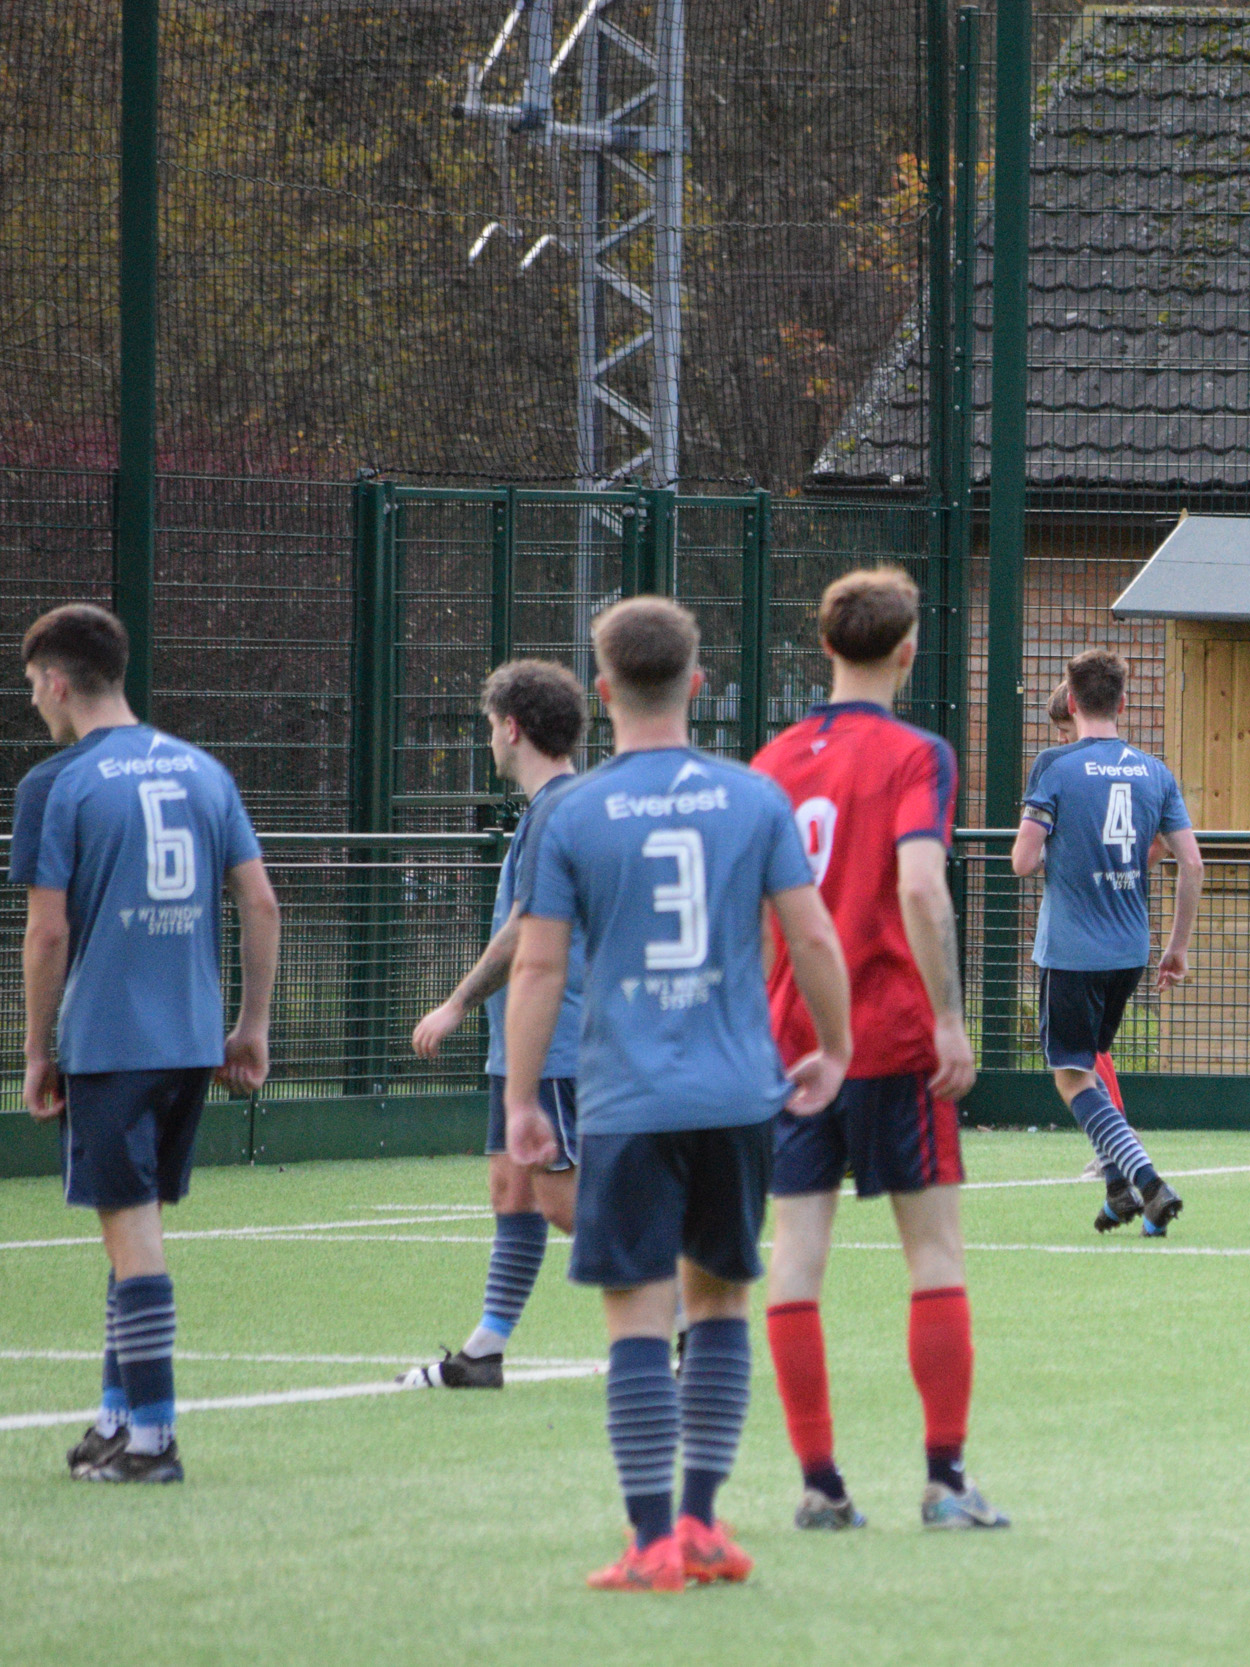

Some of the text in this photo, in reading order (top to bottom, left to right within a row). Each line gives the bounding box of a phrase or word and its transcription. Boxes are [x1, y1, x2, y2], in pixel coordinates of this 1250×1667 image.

[98, 755, 198, 779] Everest
[1085, 761, 1149, 777] Everest
[604, 786, 728, 820] Everest
[1102, 783, 1137, 864] 4
[138, 779, 196, 901] 6
[641, 828, 709, 971] 3
